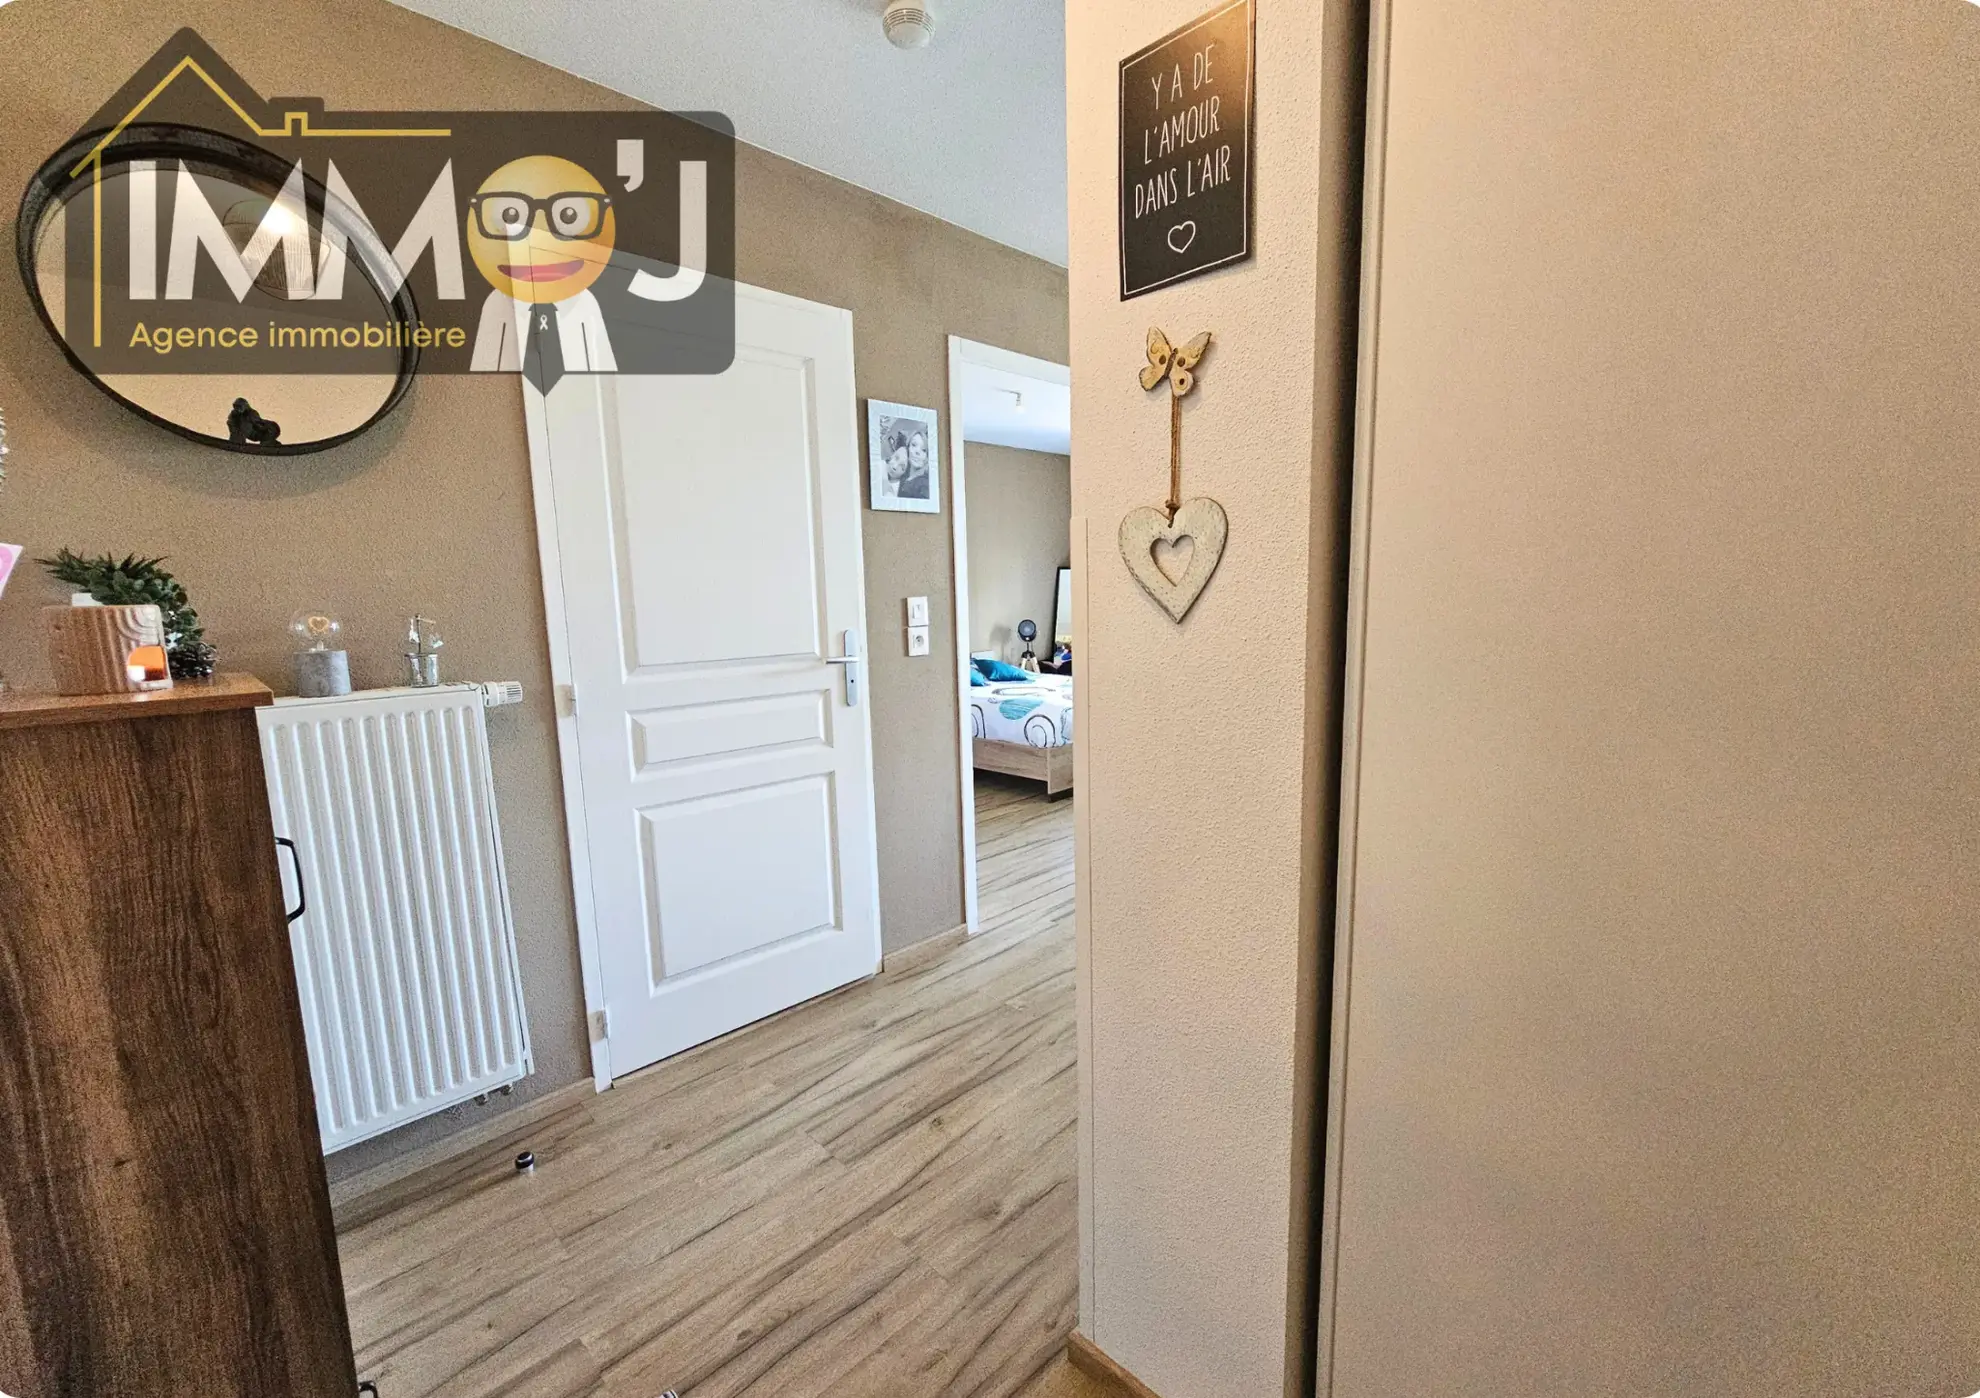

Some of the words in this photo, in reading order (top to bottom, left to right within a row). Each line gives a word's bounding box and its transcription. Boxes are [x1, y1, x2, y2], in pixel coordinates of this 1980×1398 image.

[1152, 72, 1163, 111] Y
[1170, 62, 1183, 103] A
[1193, 44, 1215, 91] DE
[1144, 95, 1220, 165] L'AMOUR
[1134, 167, 1178, 219] DANS
[1187, 145, 1231, 198] L'AIR
